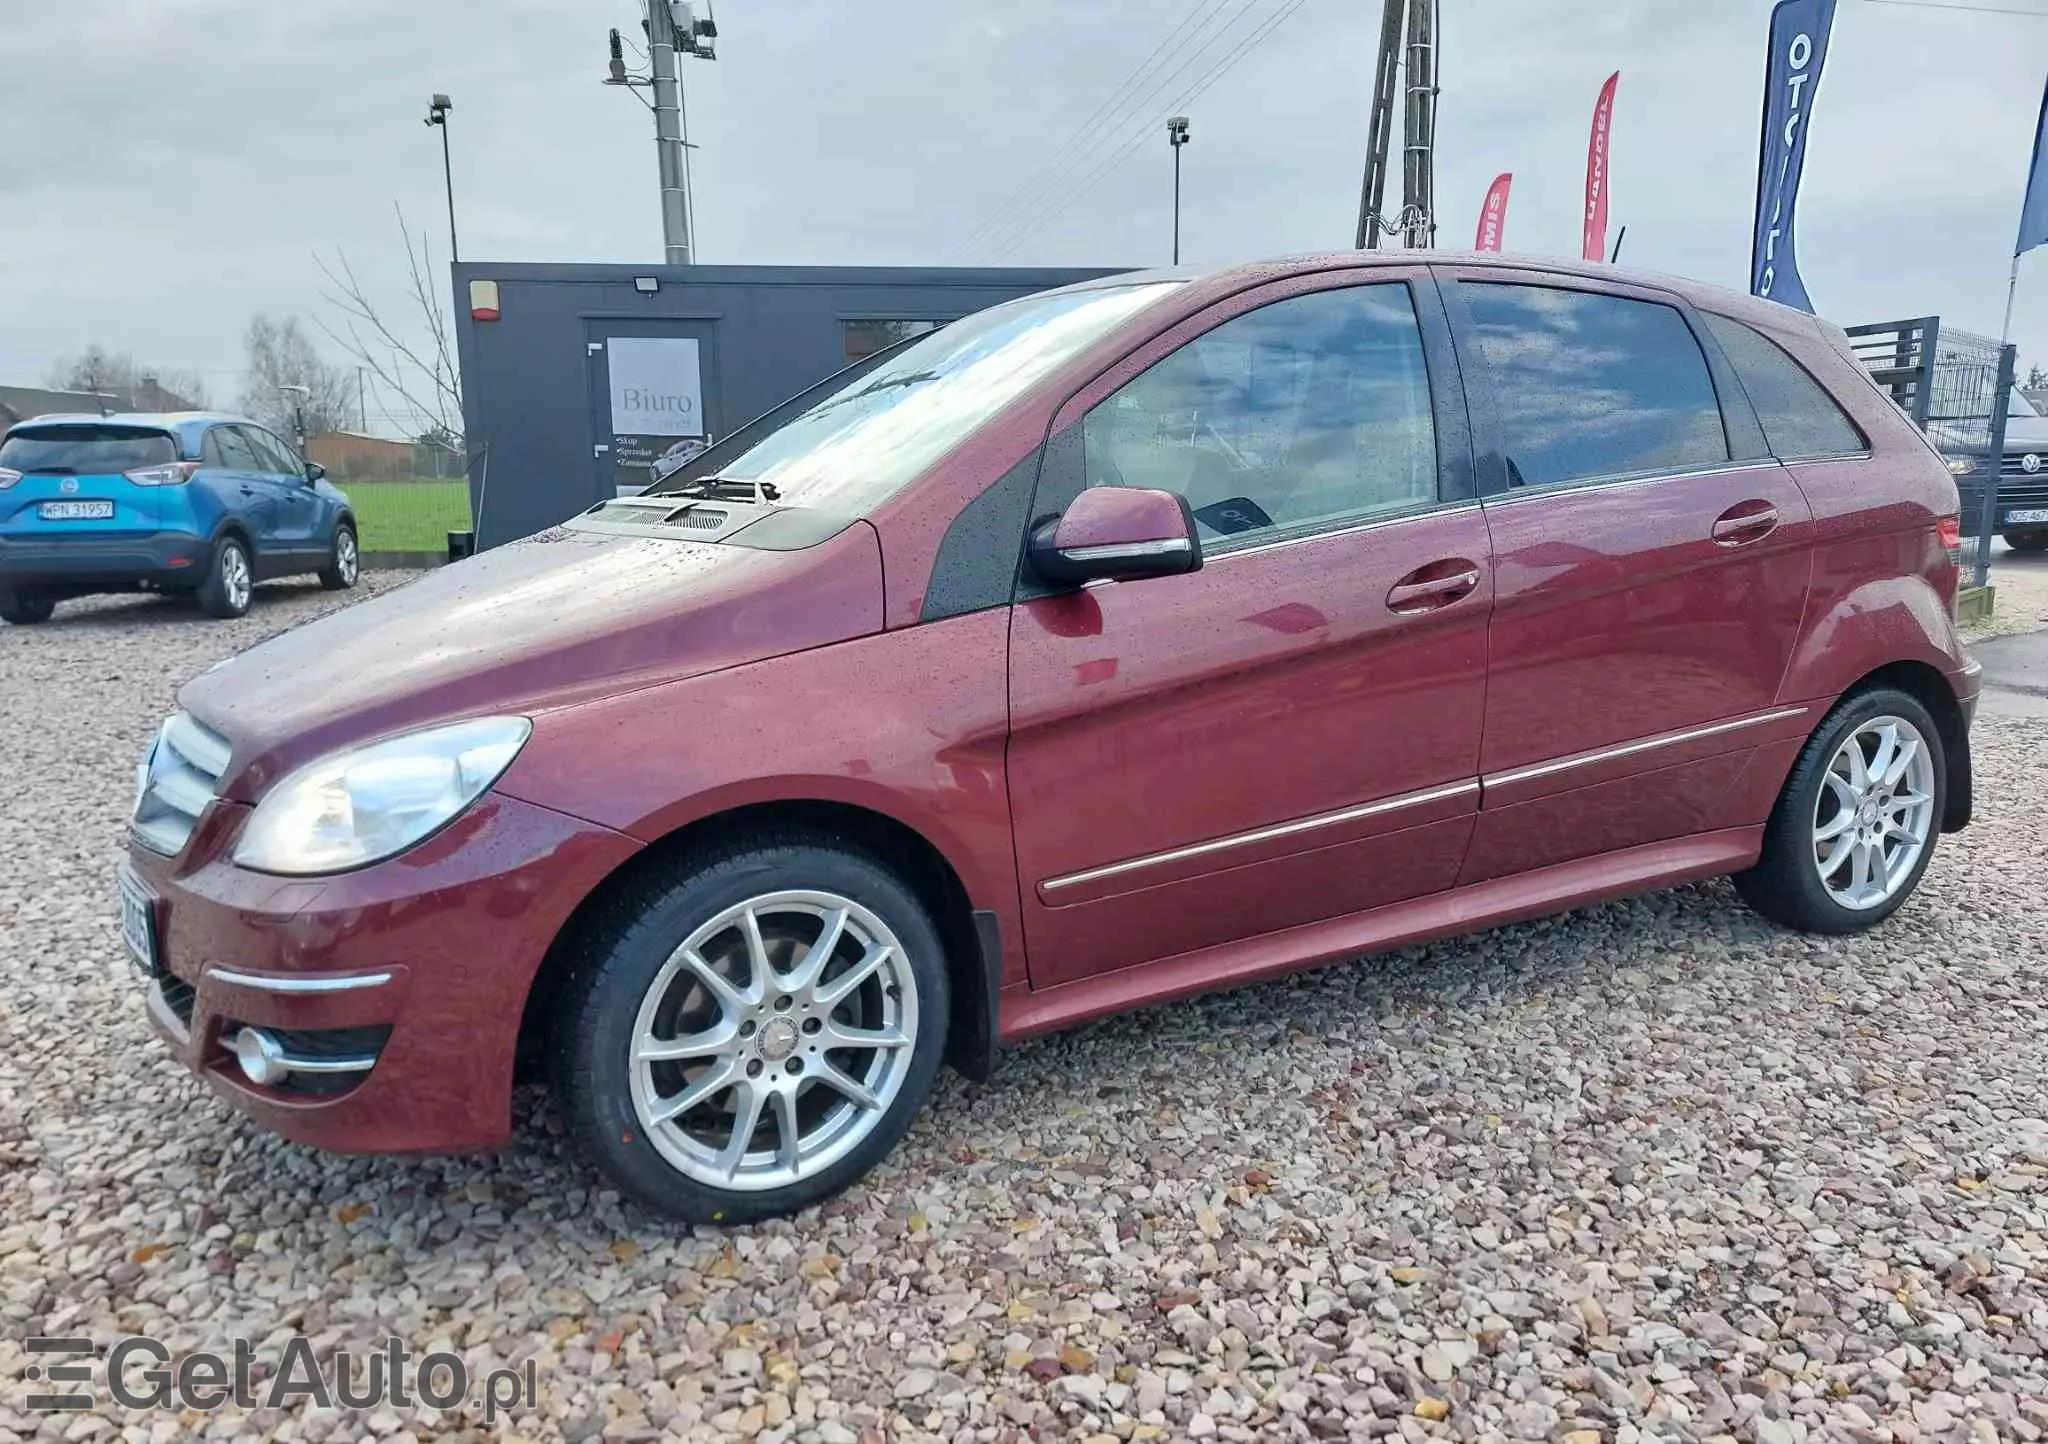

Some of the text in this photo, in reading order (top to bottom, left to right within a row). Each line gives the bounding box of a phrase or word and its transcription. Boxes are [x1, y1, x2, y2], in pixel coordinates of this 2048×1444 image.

[1761, 33, 1812, 297] OTOTO
[1484, 192, 1501, 252] MIS
[622, 388, 692, 413] Biuro
